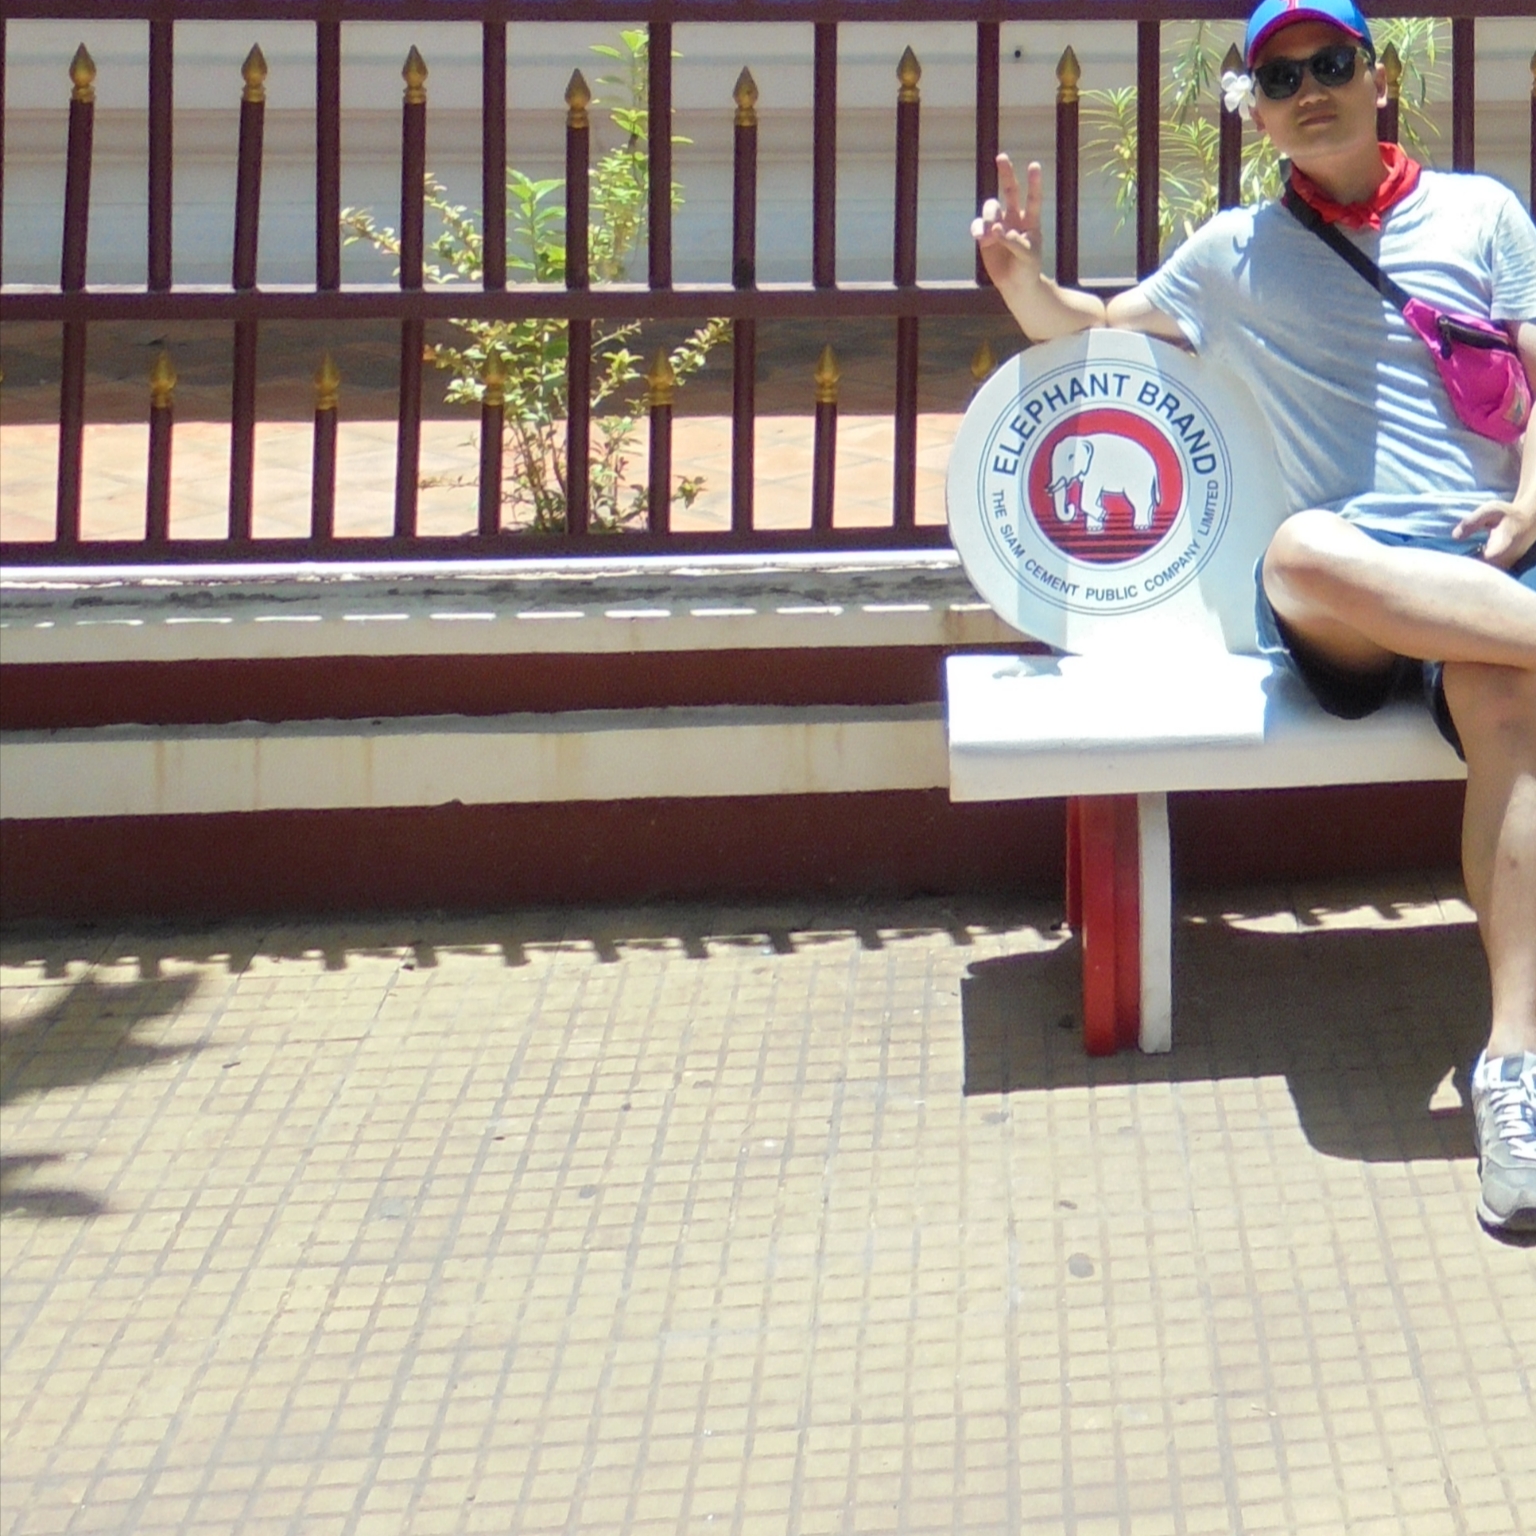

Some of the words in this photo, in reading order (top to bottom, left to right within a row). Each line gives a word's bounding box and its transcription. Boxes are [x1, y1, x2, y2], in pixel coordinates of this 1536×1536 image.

[992, 372, 1131, 476] ELEPHANT
[1136, 380, 1217, 475] BRAND
[992, 489, 1007, 519] THE
[1000, 524, 1026, 559] SIAM
[1024, 558, 1080, 596] CEMENT
[1085, 585, 1138, 602] PUBLIC
[1144, 538, 1201, 592] COMPANY
[1197, 479, 1219, 537] LIMITED
